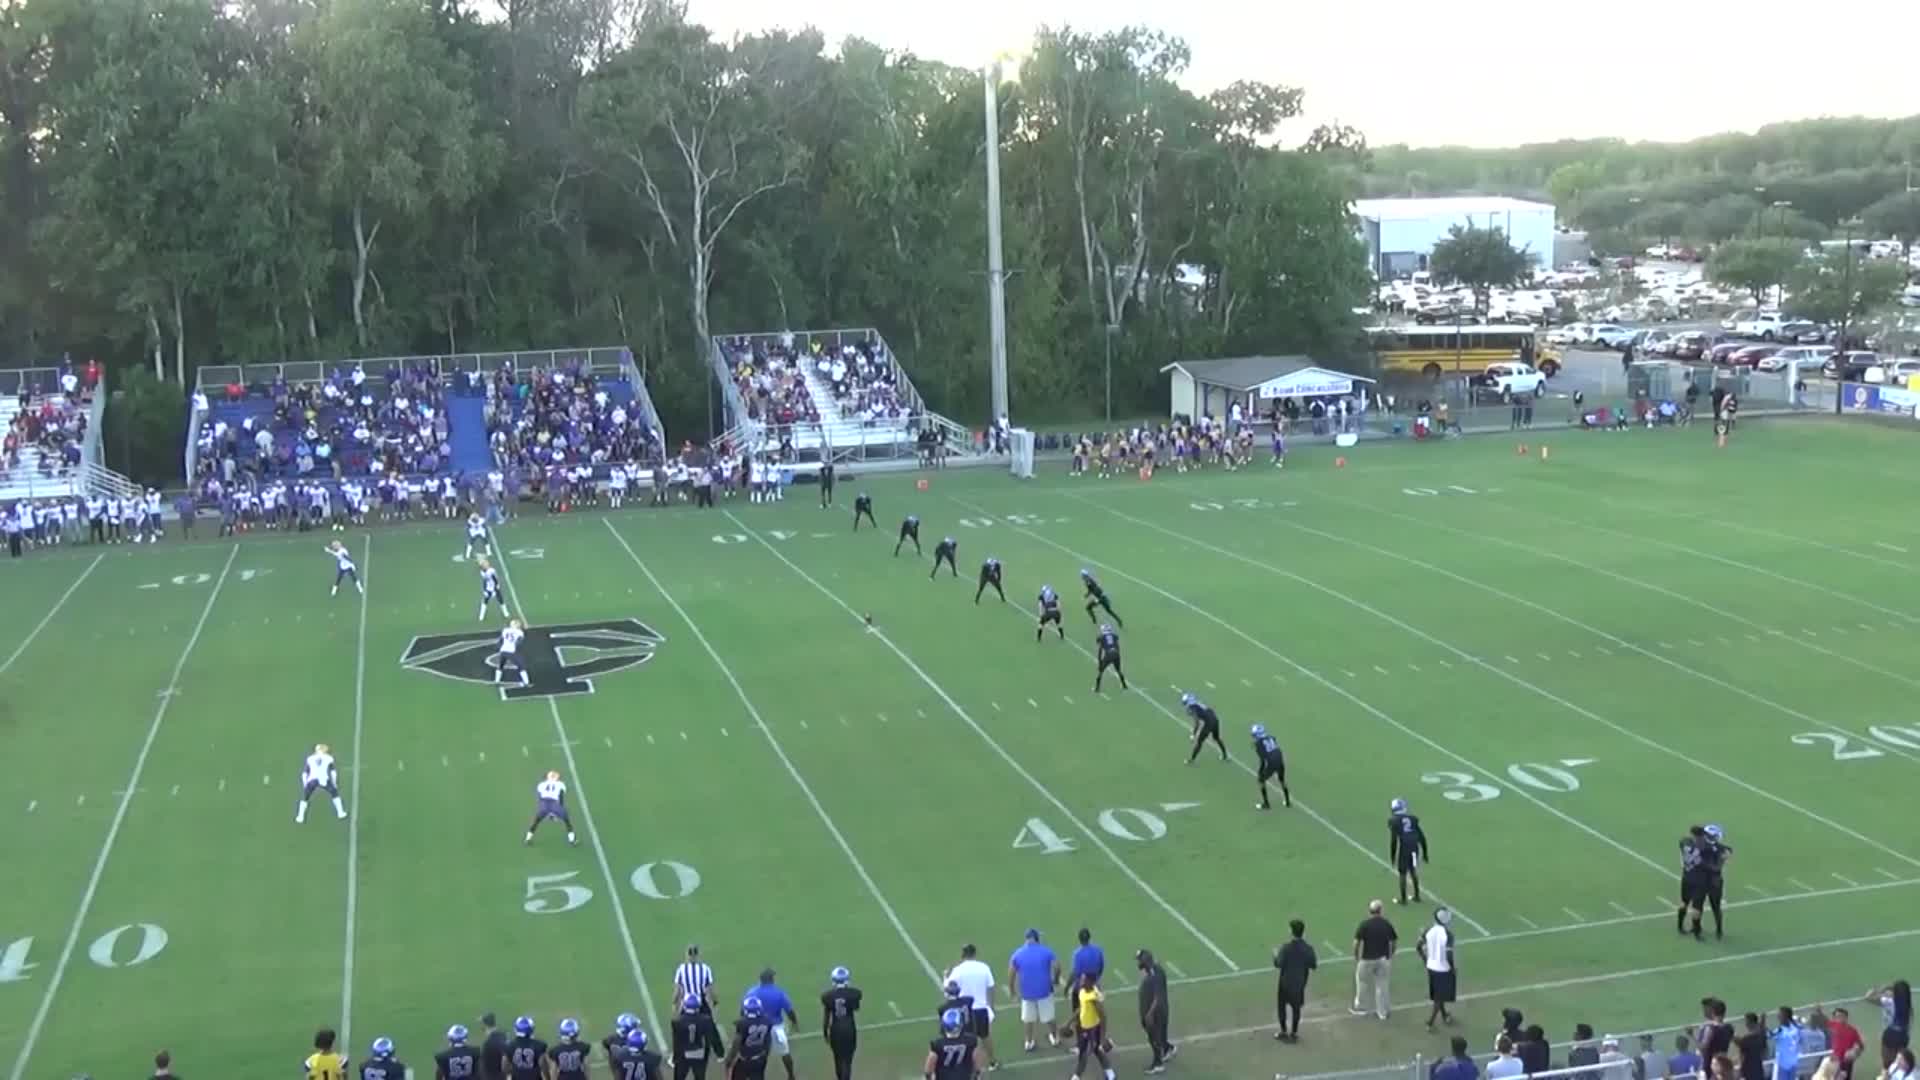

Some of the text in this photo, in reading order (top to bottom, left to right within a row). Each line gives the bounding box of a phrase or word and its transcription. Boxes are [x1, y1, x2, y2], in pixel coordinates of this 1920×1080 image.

[1011, 808, 1168, 855] 40
[524, 860, 700, 913] 50
[943, 1045, 967, 1067] 77
